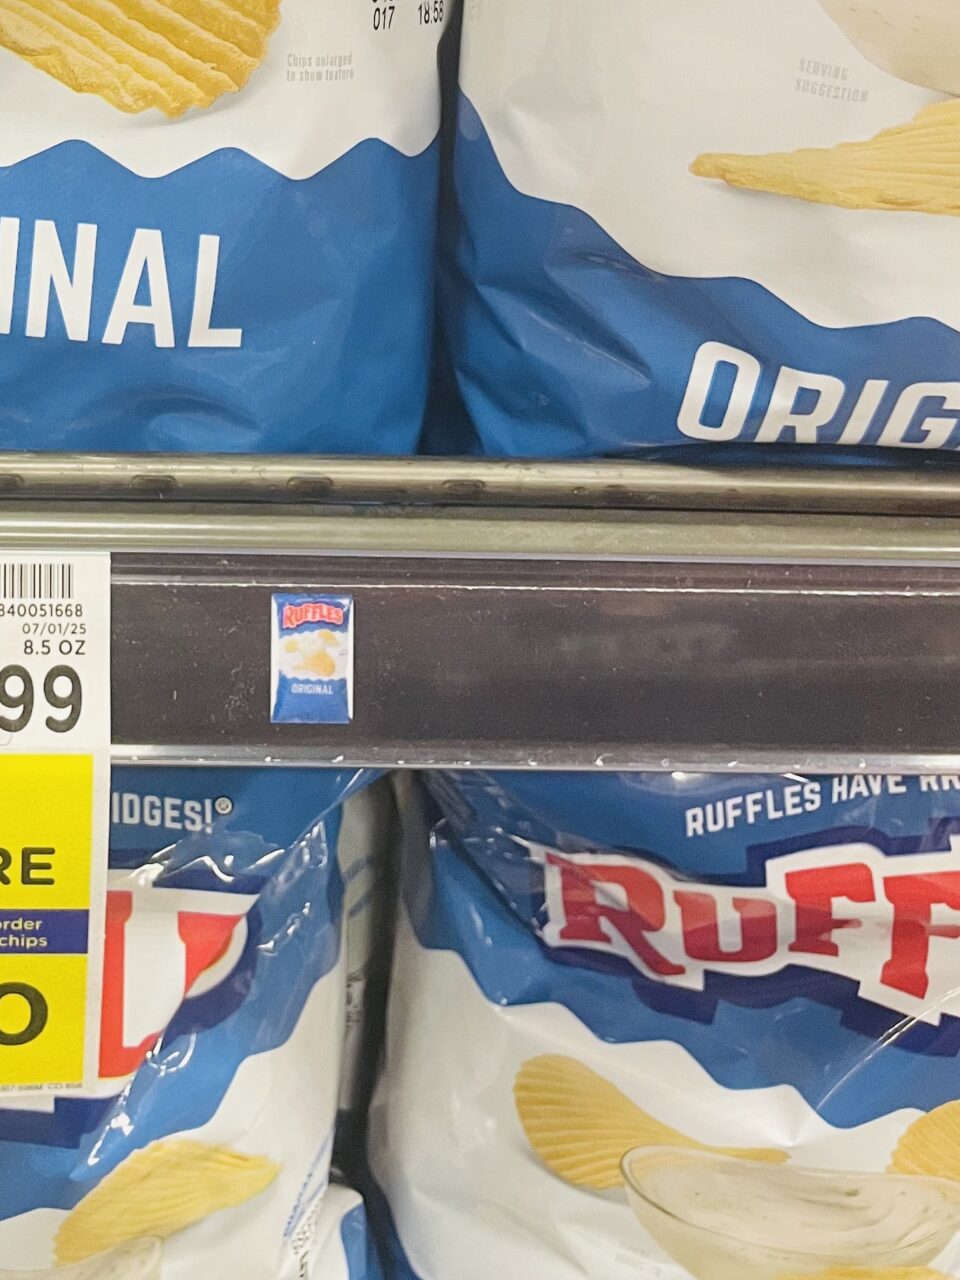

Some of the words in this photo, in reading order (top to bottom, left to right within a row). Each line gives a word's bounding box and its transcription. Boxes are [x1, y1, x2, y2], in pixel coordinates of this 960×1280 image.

[373, 5, 395, 30] 017
[798, 58, 848, 81] SERVING
[794, 78, 869, 102] SUGGESTION
[283, 603, 344, 628] RUFFLES
[22, 623, 87, 636] 07/01/25
[24, 640, 51, 656] 8.5
[59, 639, 87, 656] OZ
[291, 683, 334, 695] ORIGINAL
[112, 792, 212, 833] IDGES!
[686, 781, 822, 837] RUFFLES
[832, 774, 907, 803] HAVE
